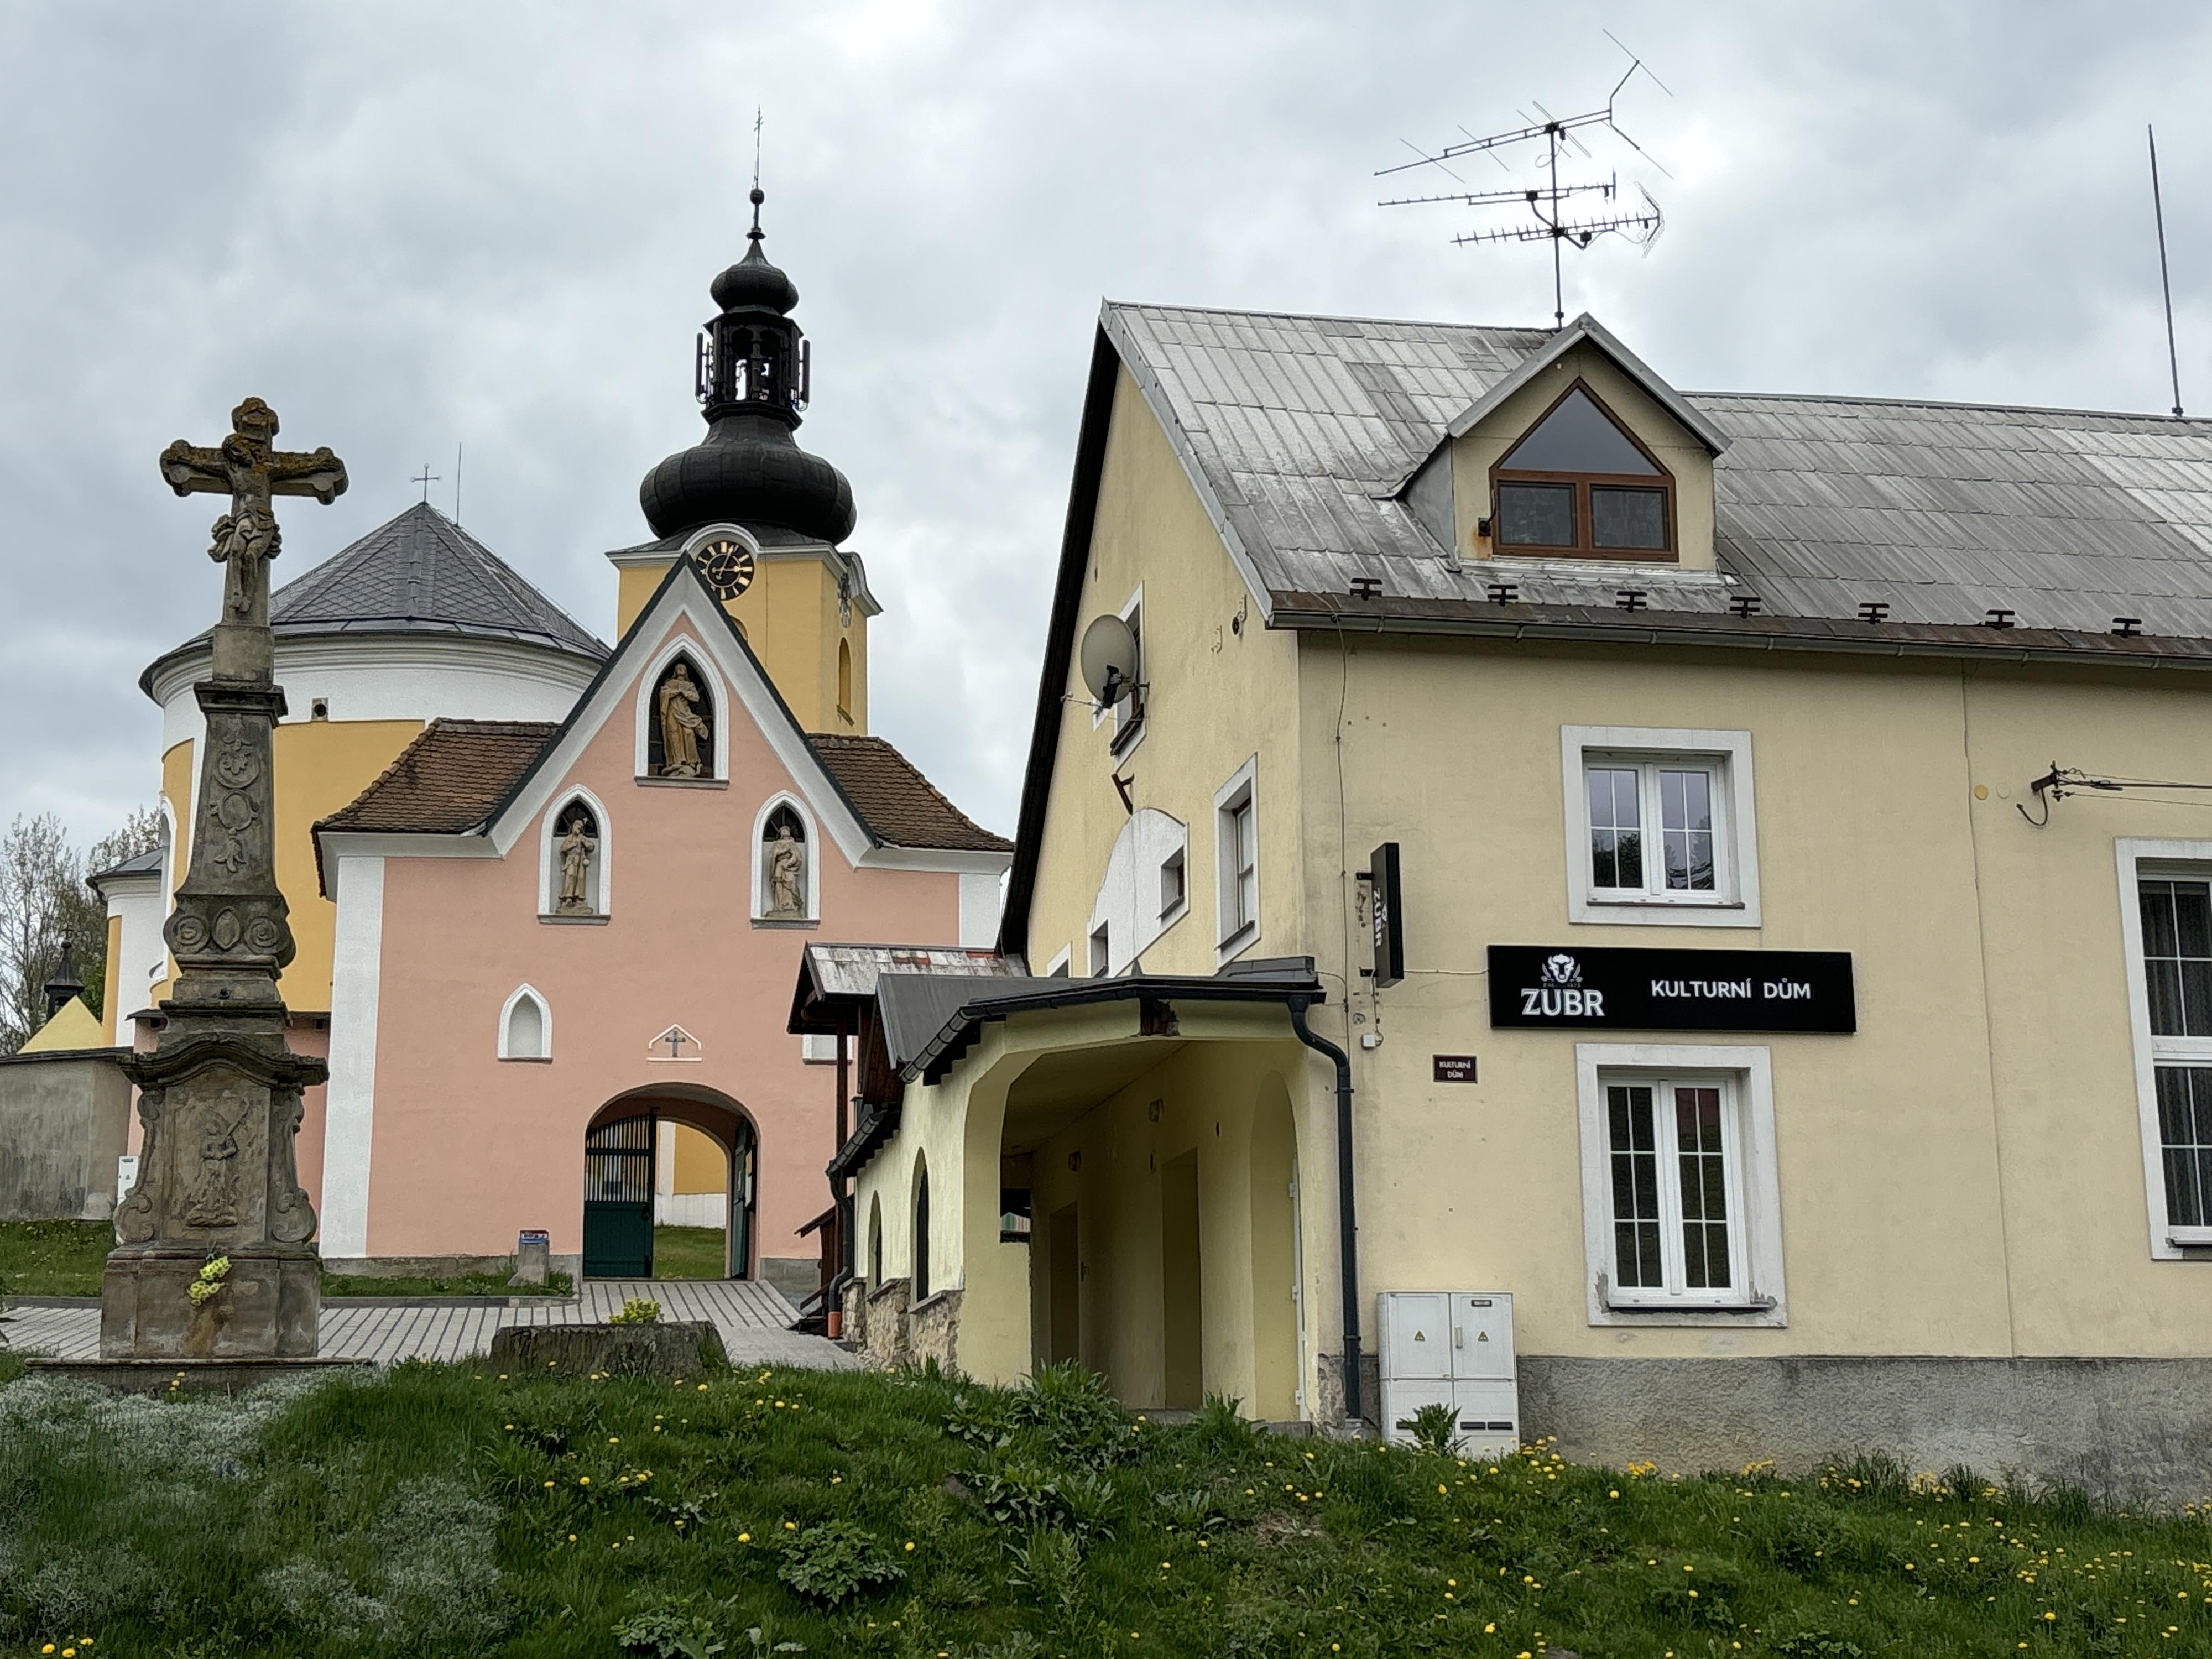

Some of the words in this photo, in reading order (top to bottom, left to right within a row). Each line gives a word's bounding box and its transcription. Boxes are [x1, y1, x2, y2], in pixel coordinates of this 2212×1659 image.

[1651, 978, 1752, 998] KULTURNÍ
[1763, 978, 1811, 999] DŮM
[1521, 988, 1605, 1016] ZUBR
